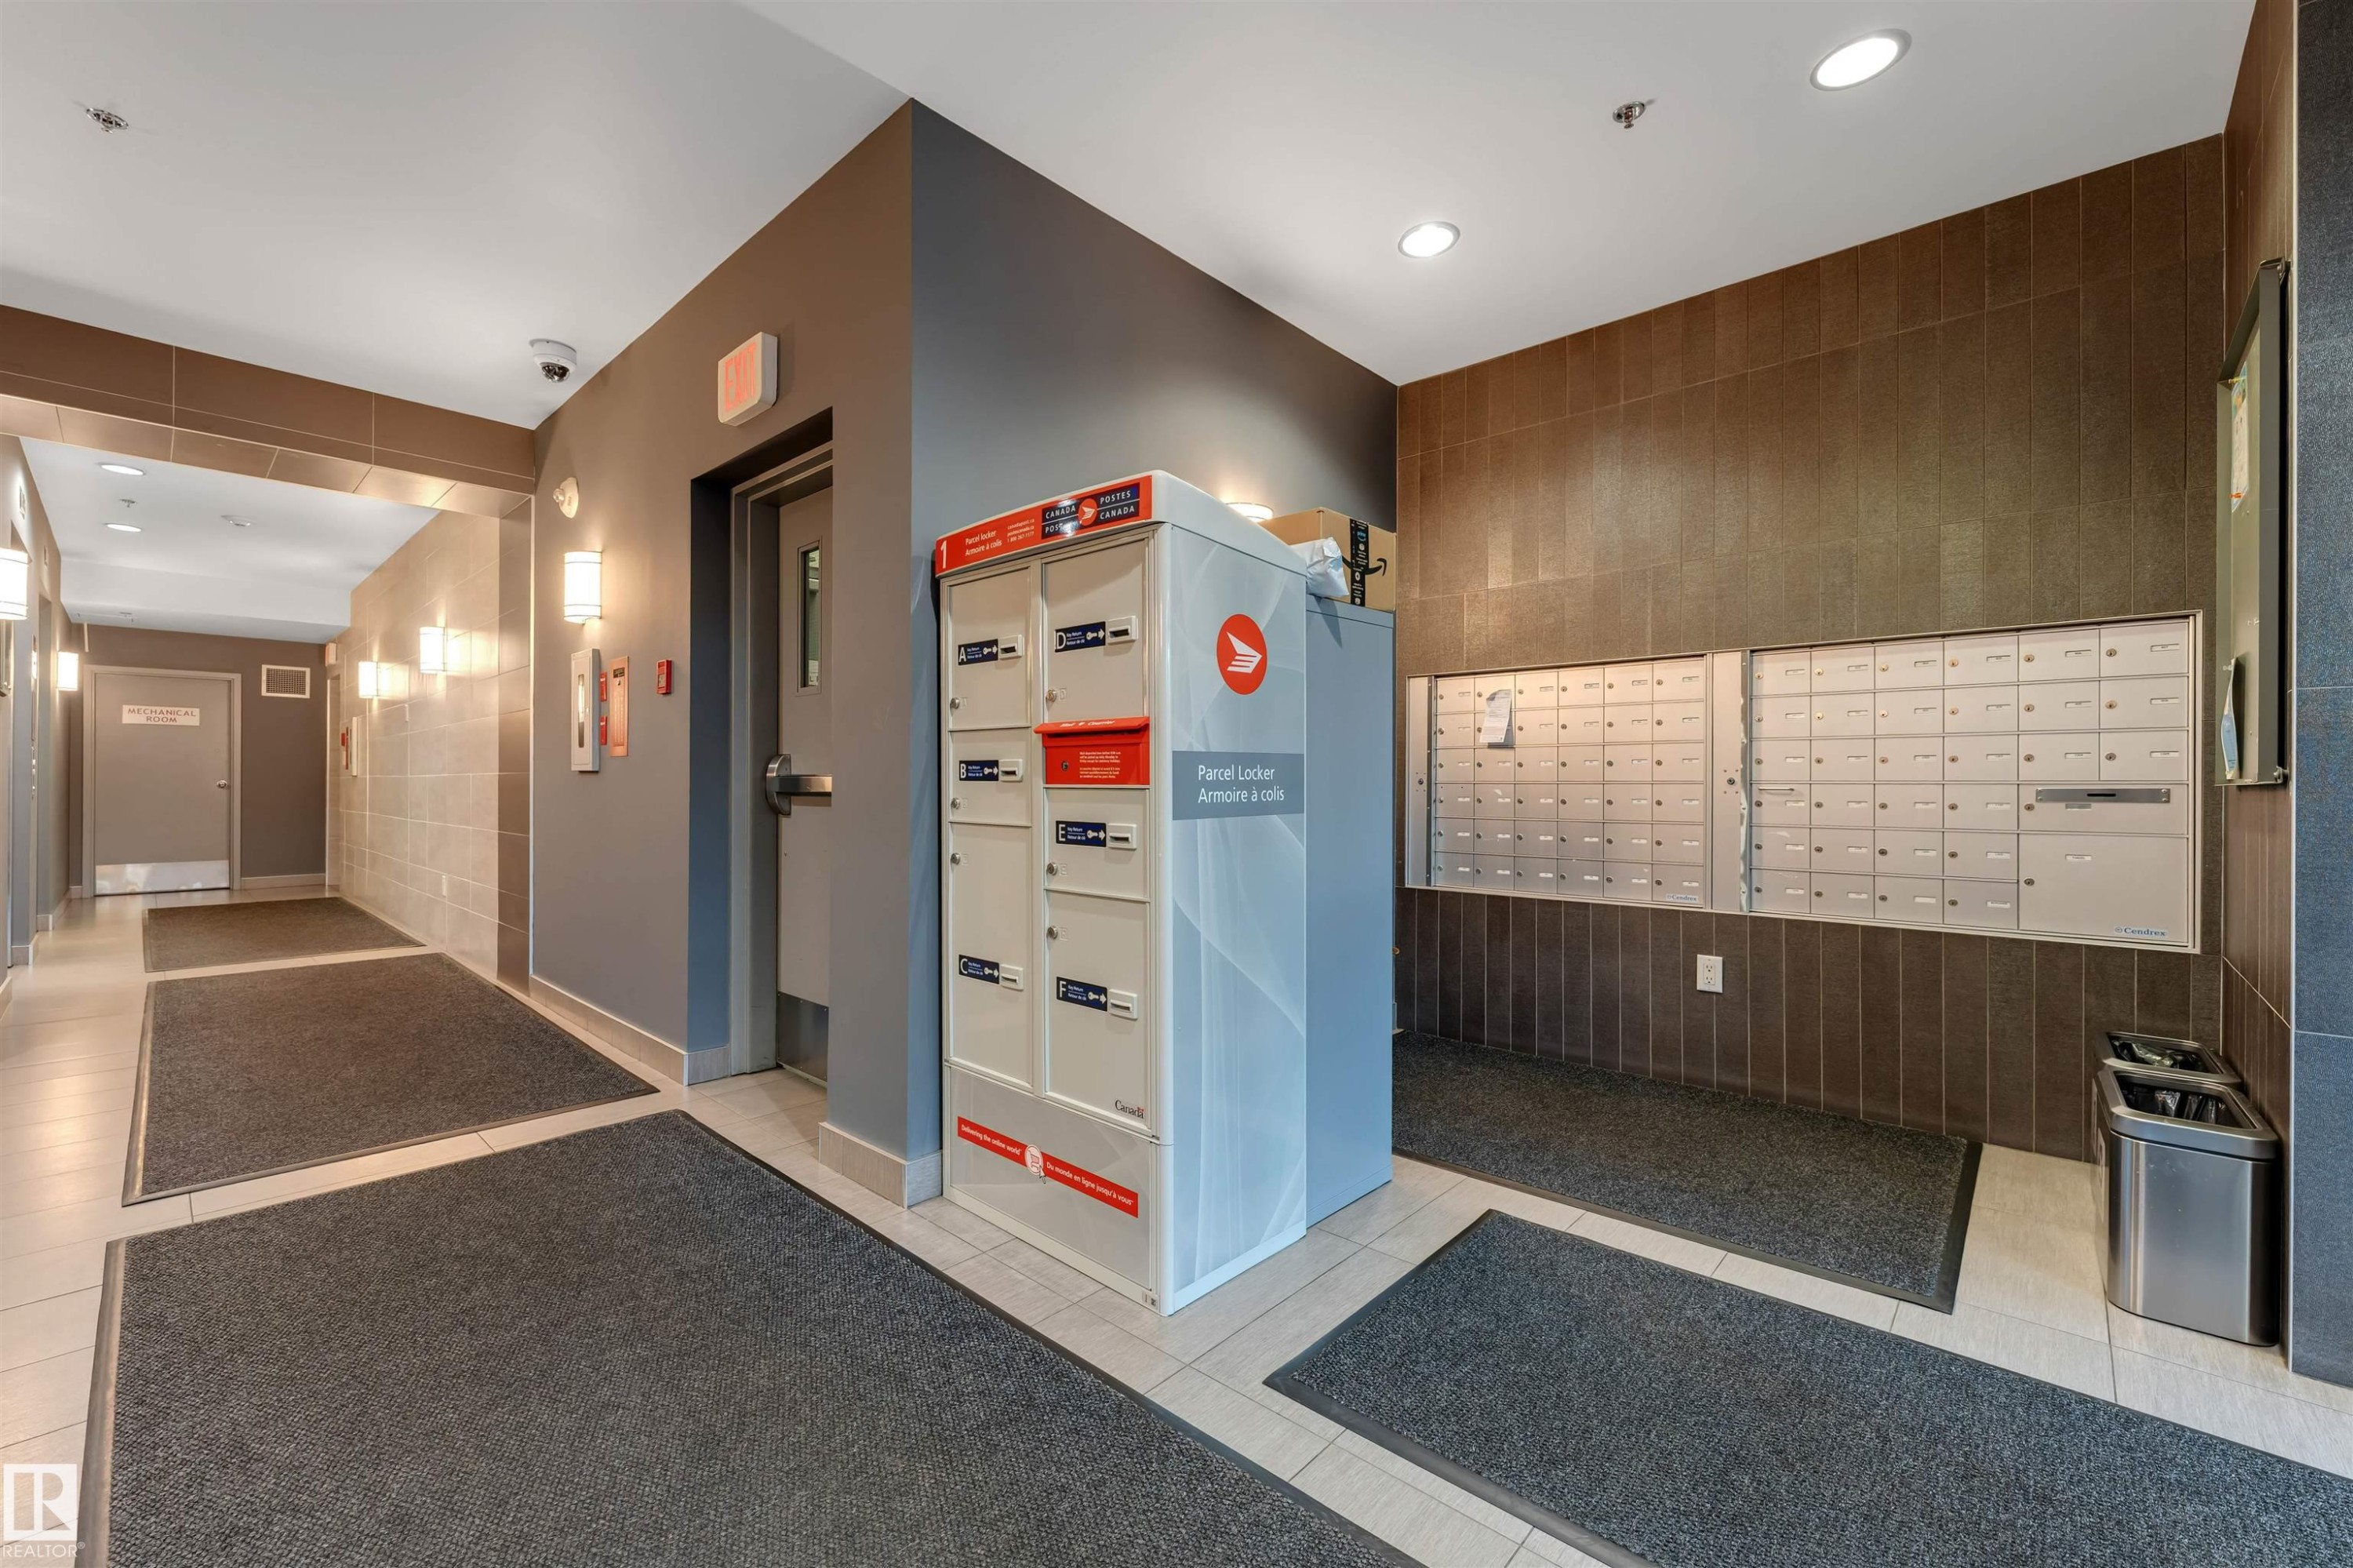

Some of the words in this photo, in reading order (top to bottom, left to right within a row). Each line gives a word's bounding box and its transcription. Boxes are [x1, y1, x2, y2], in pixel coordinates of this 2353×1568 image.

[725, 343, 757, 412] EXIT
[1100, 490, 1131, 504] POSTES
[1046, 505, 1076, 519] CANADA
[1100, 505, 1135, 519] CANADA
[966, 534, 980, 545] Parcel
[980, 530, 996, 540] locker
[940, 540, 947, 569] 1
[966, 545, 985, 556] Armoire
[990, 539, 1002, 548] colis
[1056, 632, 1067, 649] D
[958, 646, 966, 662] A
[128, 708, 196, 717] MECHANICAL
[960, 763, 966, 778] B
[1198, 764, 1235, 780] Parcel
[1238, 764, 1275, 780] Locker
[1198, 787, 1248, 803] Armoire
[1251, 787, 1257, 802] à
[1260, 786, 1284, 801] colis
[1059, 824, 1066, 841] E
[2123, 927, 2166, 937] Cendrex
[960, 959, 968, 973] C
[1060, 980, 1067, 998] F
[1115, 1100, 1144, 1119] Canada
[961, 1124, 983, 1140] Delivering
[983, 1134, 991, 1143] the
[991, 1139, 1006, 1148] online
[1046, 1162, 1054, 1170] Du
[1055, 1166, 1073, 1179] monde
[1074, 1174, 1081, 1183] en
[1082, 1177, 1095, 1188] ligne
